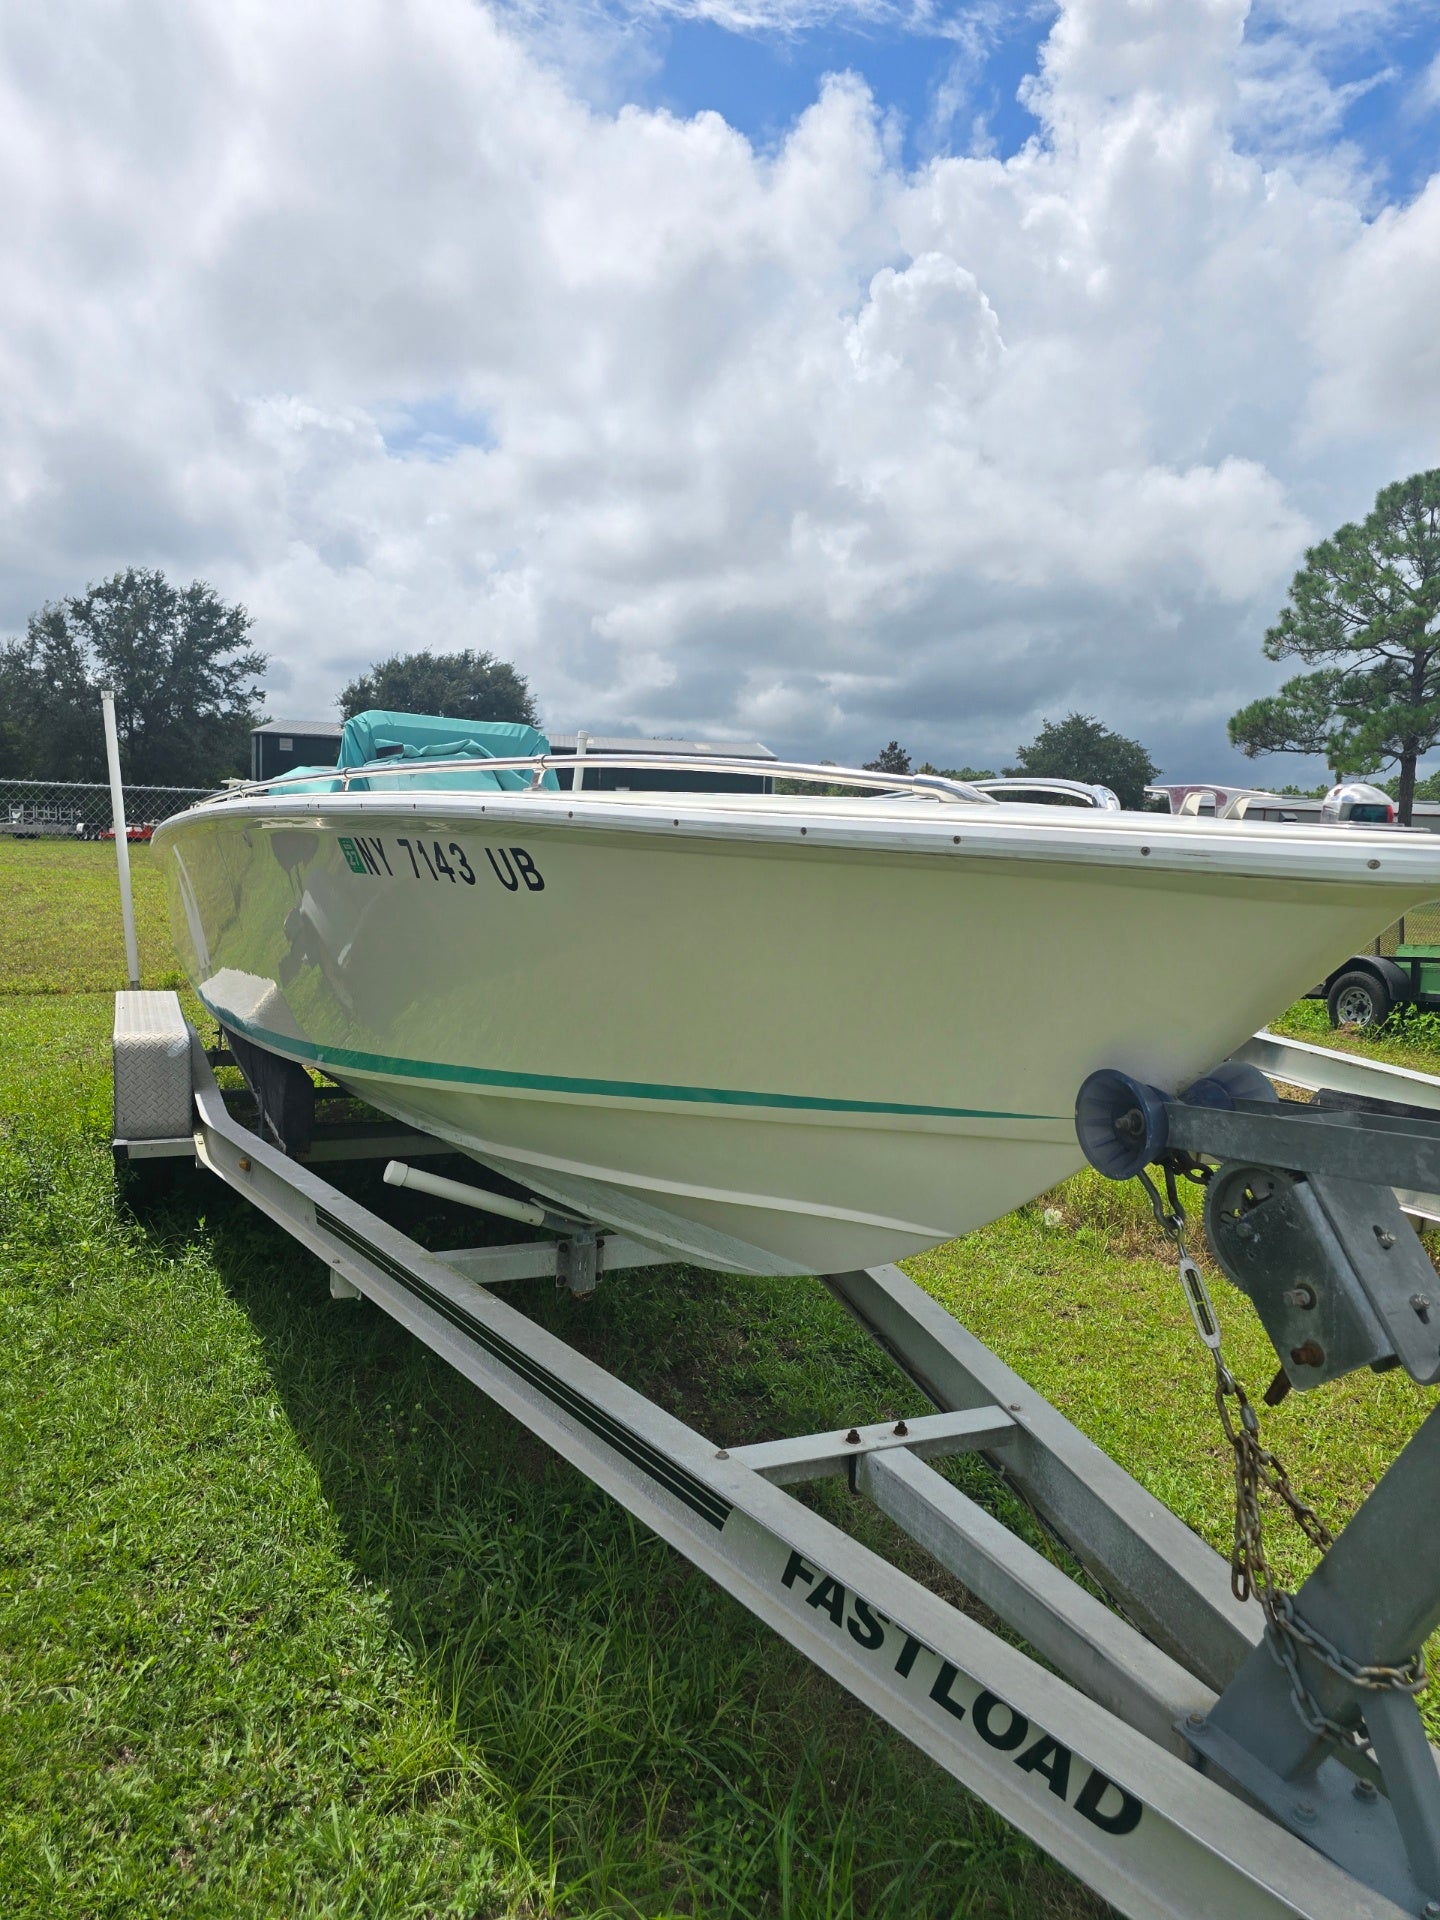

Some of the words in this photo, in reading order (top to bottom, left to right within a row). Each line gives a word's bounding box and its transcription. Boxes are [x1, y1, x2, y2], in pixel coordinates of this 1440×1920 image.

[353, 837, 393, 876] NY
[397, 838, 476, 885] 7143
[485, 847, 545, 891] UB
[780, 1549, 1143, 1835] FASTLOAD
